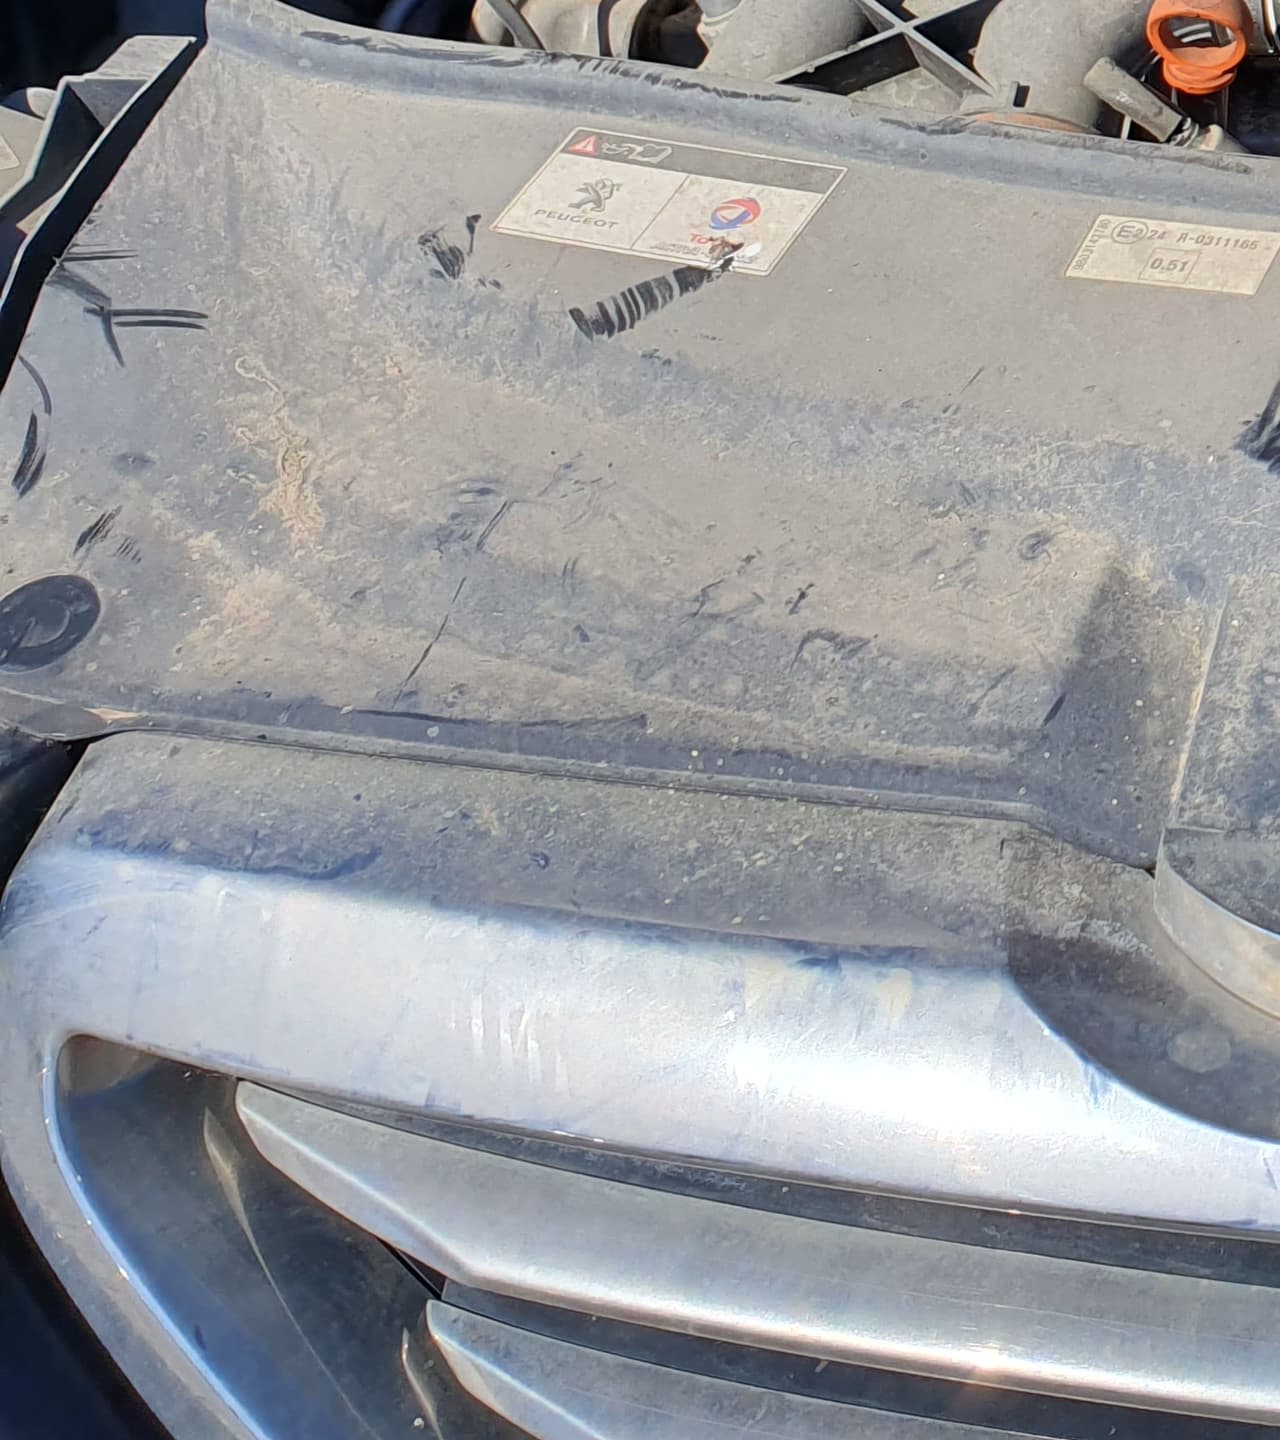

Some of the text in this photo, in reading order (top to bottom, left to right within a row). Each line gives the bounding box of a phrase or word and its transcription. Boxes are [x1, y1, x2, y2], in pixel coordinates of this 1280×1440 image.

[535, 209, 619, 229] PEUGEOT
[1147, 230, 1166, 240] 24
[1150, 257, 1189, 273] 0.51
